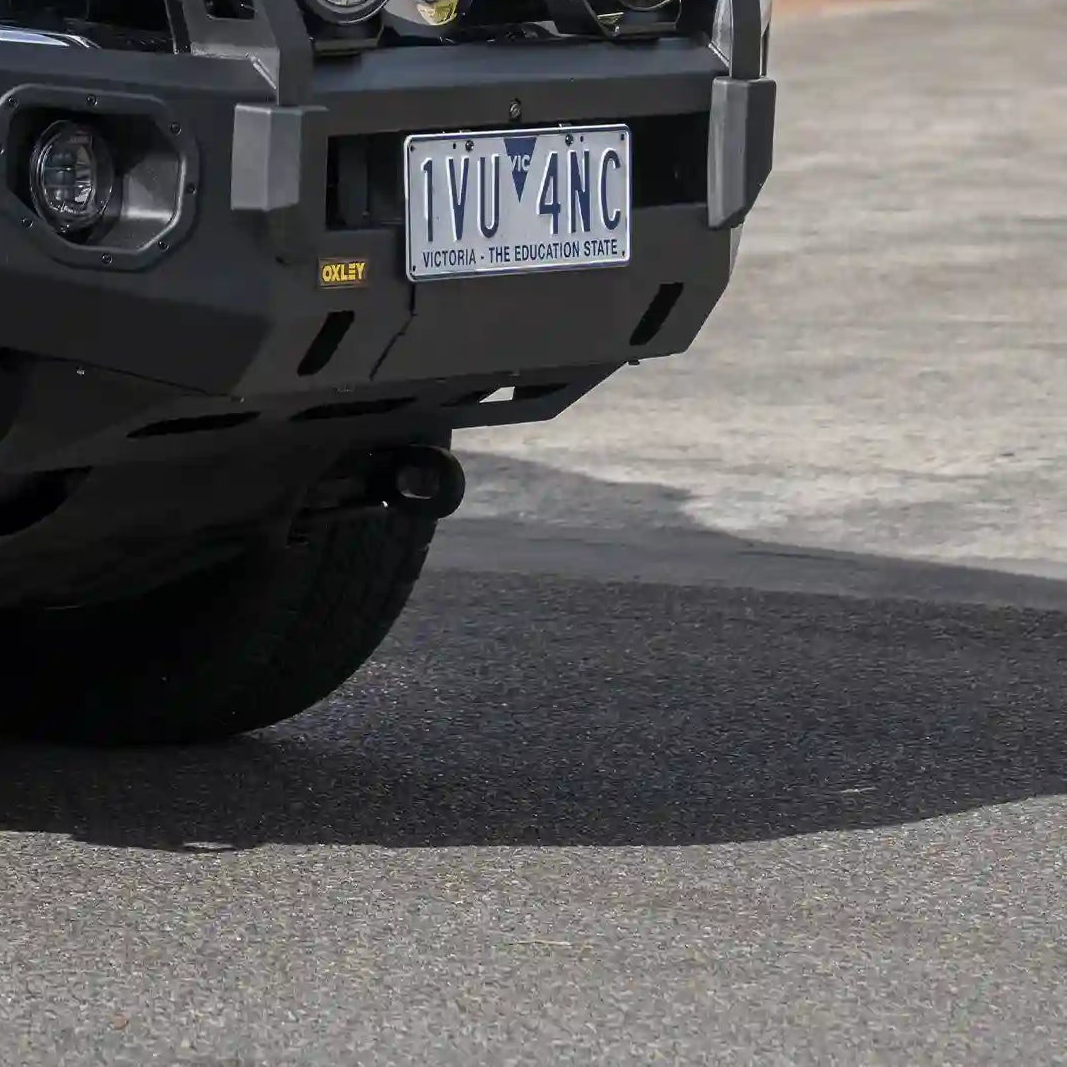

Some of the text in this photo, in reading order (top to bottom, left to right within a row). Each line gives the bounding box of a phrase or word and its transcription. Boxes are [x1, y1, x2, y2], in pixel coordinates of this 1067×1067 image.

[510, 154, 530, 172] VIC
[420, 147, 622, 242] 1VU 4NC
[422, 248, 477, 268] VICTORIA
[489, 244, 511, 263] THE
[514, 241, 581, 262] EDUCATION
[583, 238, 618, 258] STATE
[322, 262, 366, 282] OXLEY
